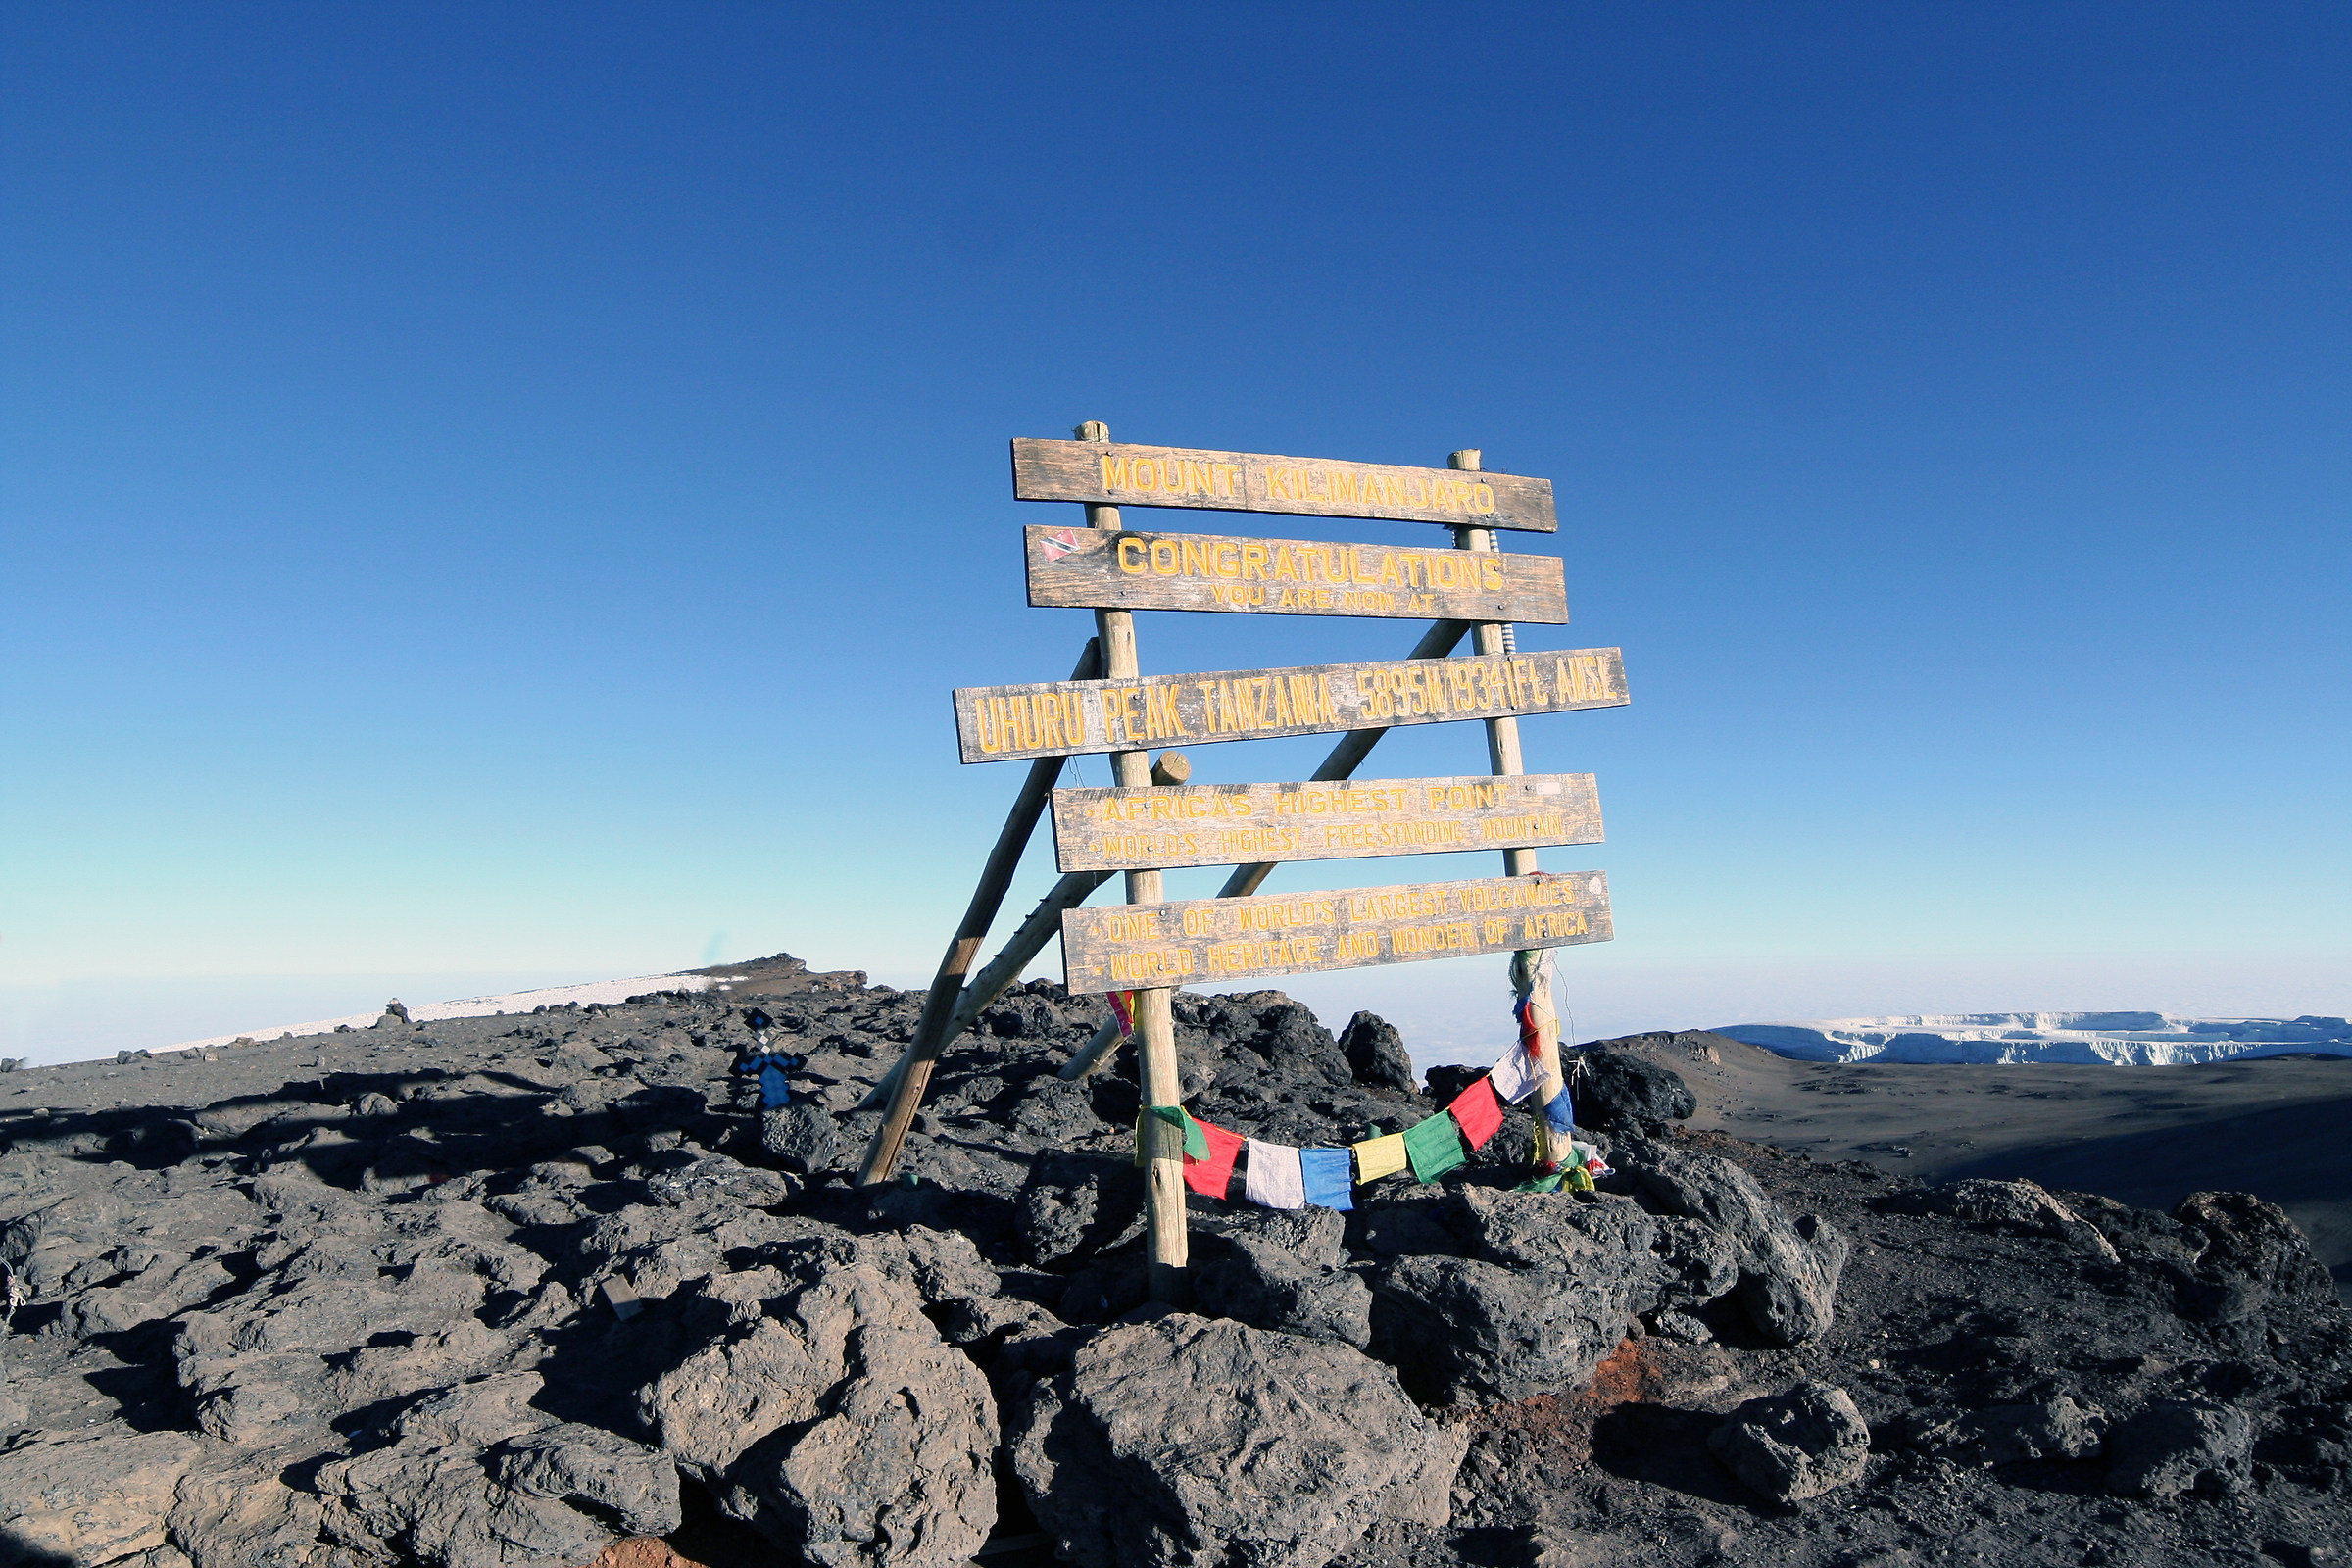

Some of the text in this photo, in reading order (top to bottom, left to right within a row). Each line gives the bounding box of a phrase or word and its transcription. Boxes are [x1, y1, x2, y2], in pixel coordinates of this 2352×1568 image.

[1101, 455, 1495, 514] MOUNT KILIMANJARO
[1117, 536, 1503, 591] CONGRATULATIONS
[1211, 584, 1436, 612] YOU ARE NOW AT
[975, 692, 1085, 754] UHURU
[1556, 656, 1617, 704] AMSL
[1274, 788, 1407, 814] HIGHEST
[1428, 784, 1510, 810] POINT
[1220, 827, 1301, 854] HIGHEST
[1481, 814, 1562, 840] MOUNTAIN
[1108, 913, 1159, 943] ONE
[1183, 909, 1214, 936] OF
[1349, 891, 1446, 923] LARGEST
[1459, 881, 1575, 913] VOLCANOES
[1110, 912, 1589, 980] WORLD HERITAGE AND WONDER OF AFRICA
